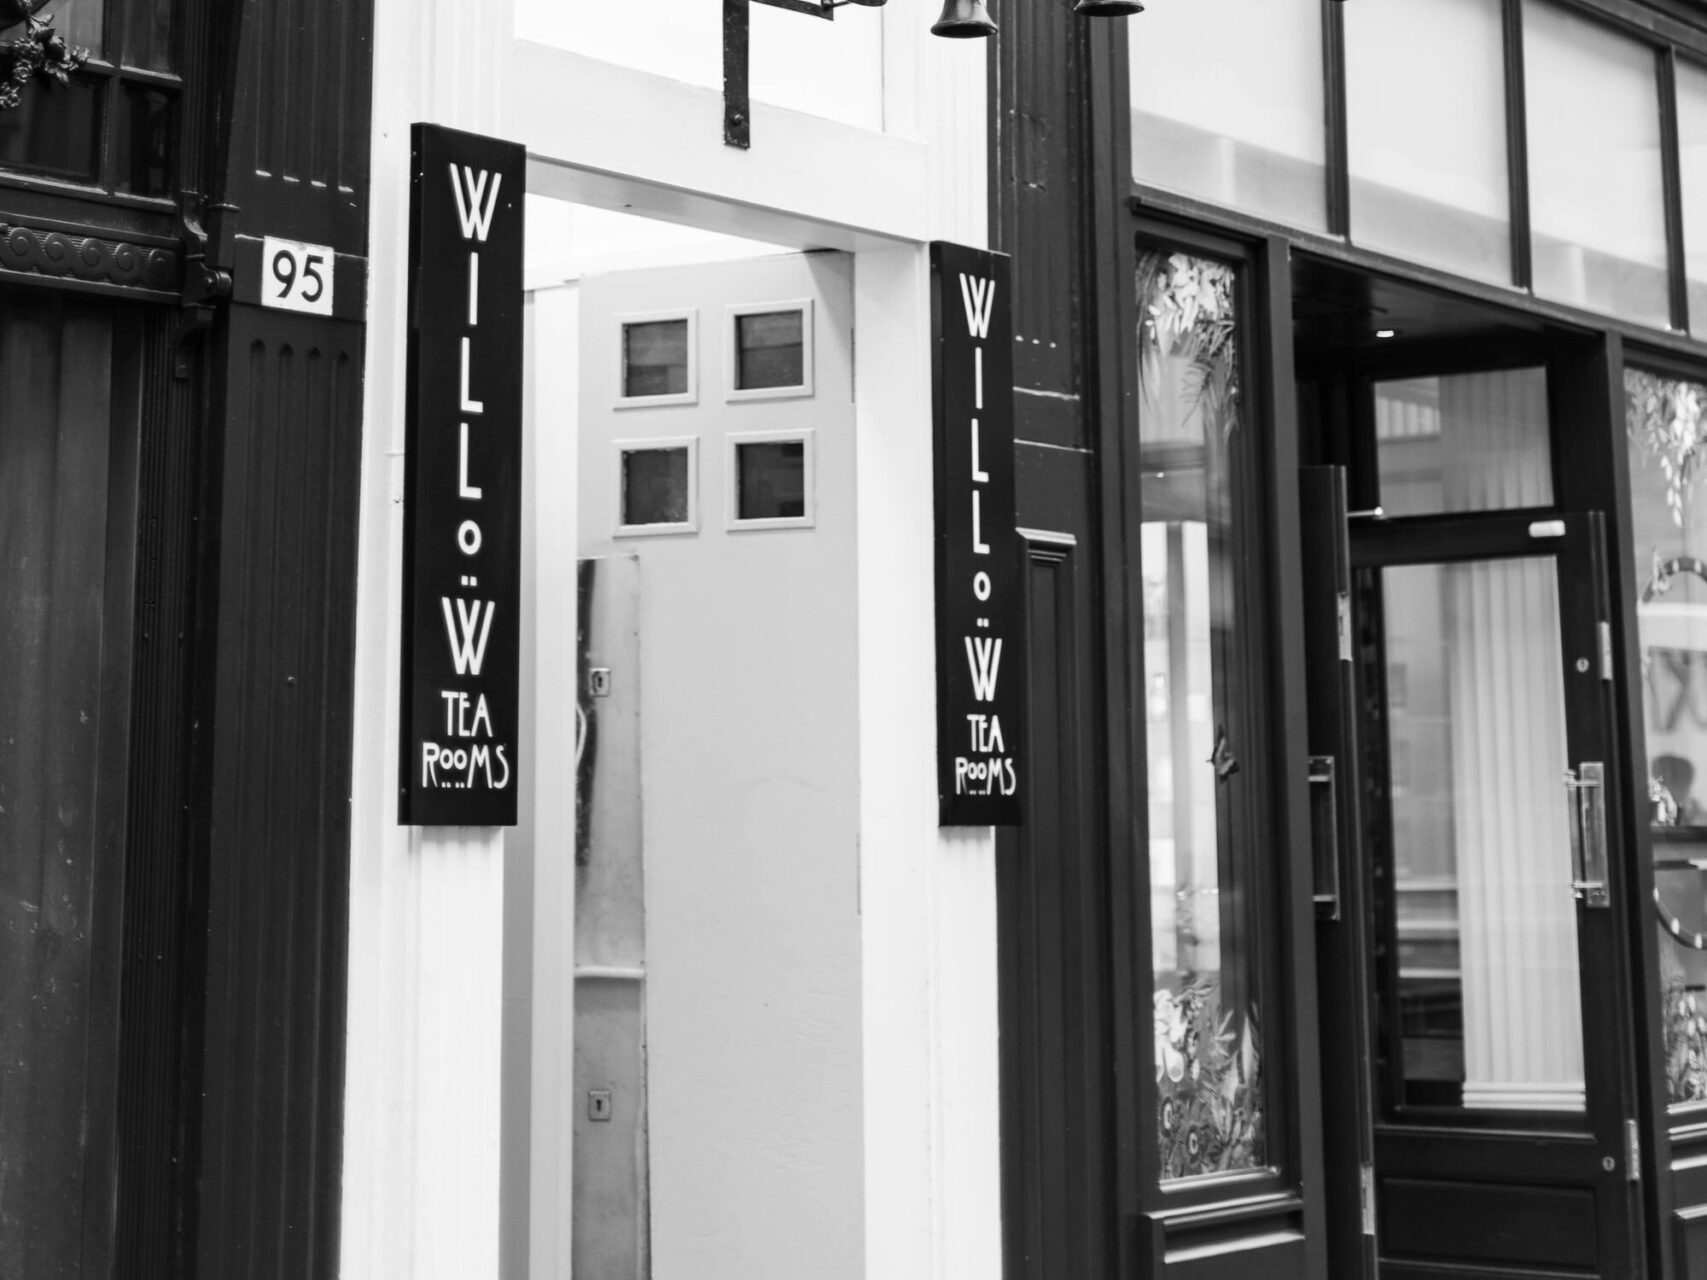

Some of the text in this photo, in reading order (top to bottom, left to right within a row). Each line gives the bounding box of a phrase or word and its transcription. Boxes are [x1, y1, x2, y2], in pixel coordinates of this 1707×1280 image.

[271, 248, 325, 303] 95
[441, 162, 502, 676] WILLOW
[958, 272, 1003, 702] WILLOW
[441, 690, 493, 738] TEA
[966, 714, 1005, 753] TEA
[422, 740, 510, 790] ROOMS
[954, 756, 1017, 796] ROOMS
